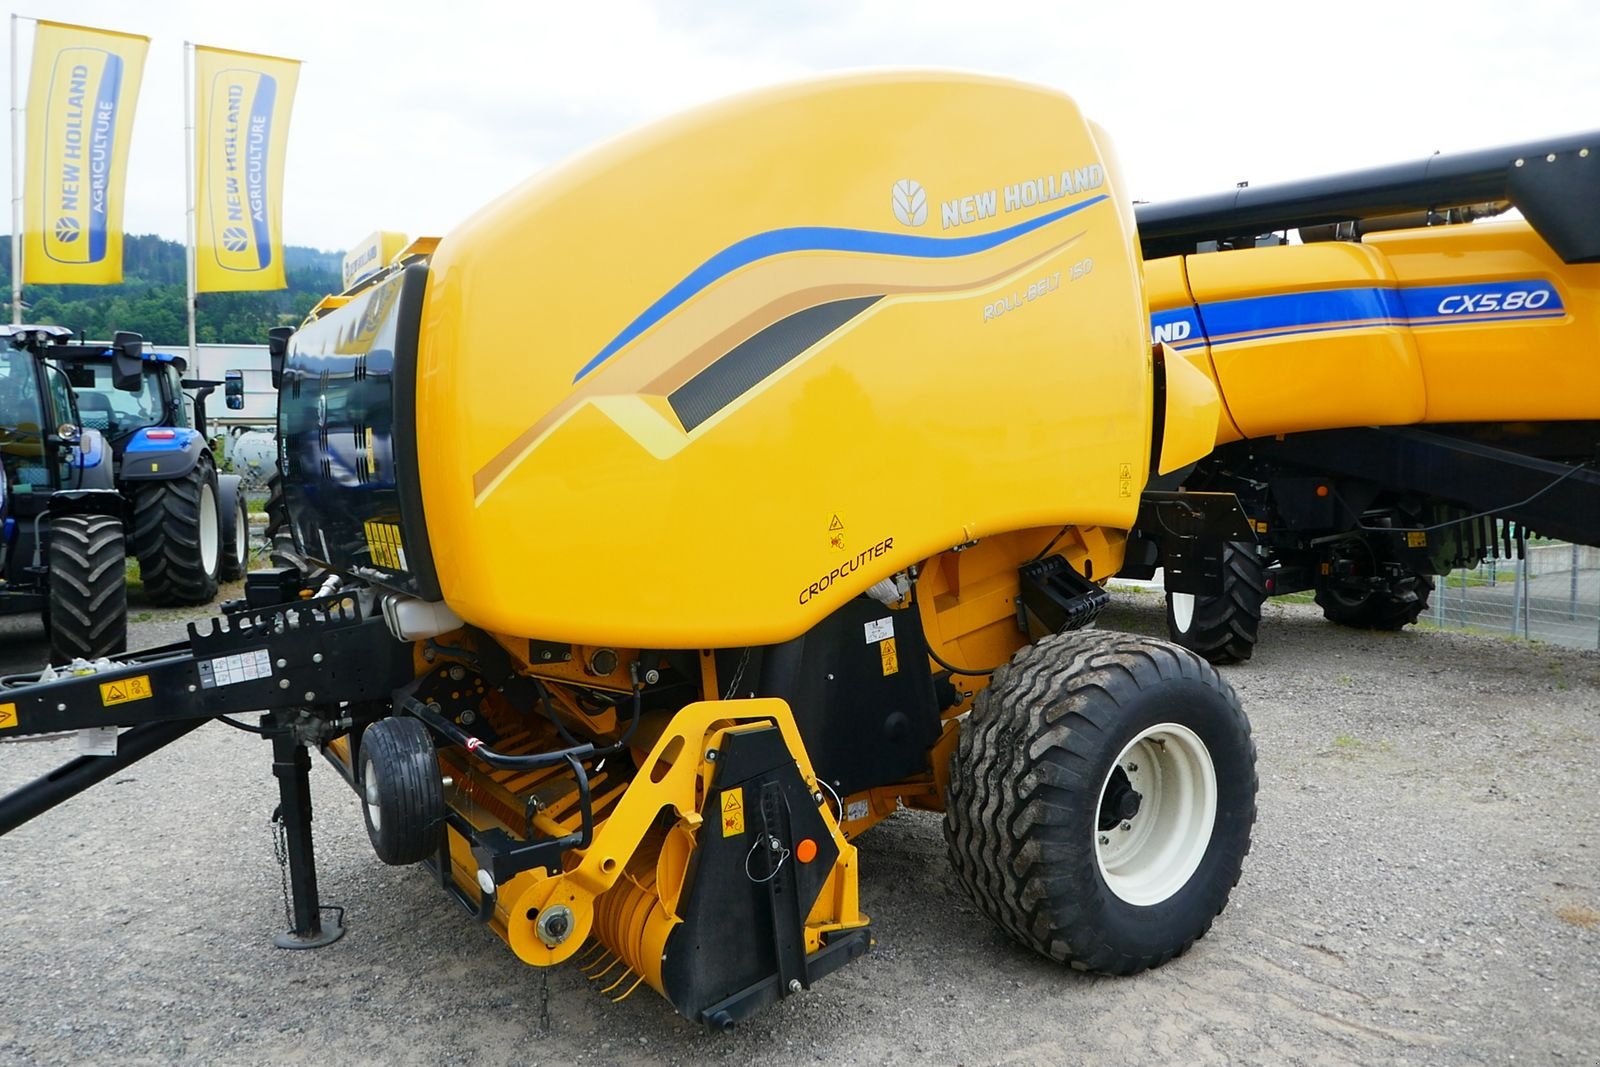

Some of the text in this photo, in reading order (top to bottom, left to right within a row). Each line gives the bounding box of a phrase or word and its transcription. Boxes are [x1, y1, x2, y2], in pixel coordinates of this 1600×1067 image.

[62, 65, 88, 210] NEW HOLLAND
[92, 101, 113, 213] AGRICULTURE
[225, 84, 243, 221] NEW HOLLAND
[249, 115, 266, 222] AGRICULTURE
[941, 163, 1105, 230] NEW HOLLAND
[983, 257, 1094, 323] ROLL-BELT 150
[1437, 290, 1550, 314] CX5.80
[1151, 320, 1191, 344] ND
[799, 537, 894, 605] CROPCUTTER
